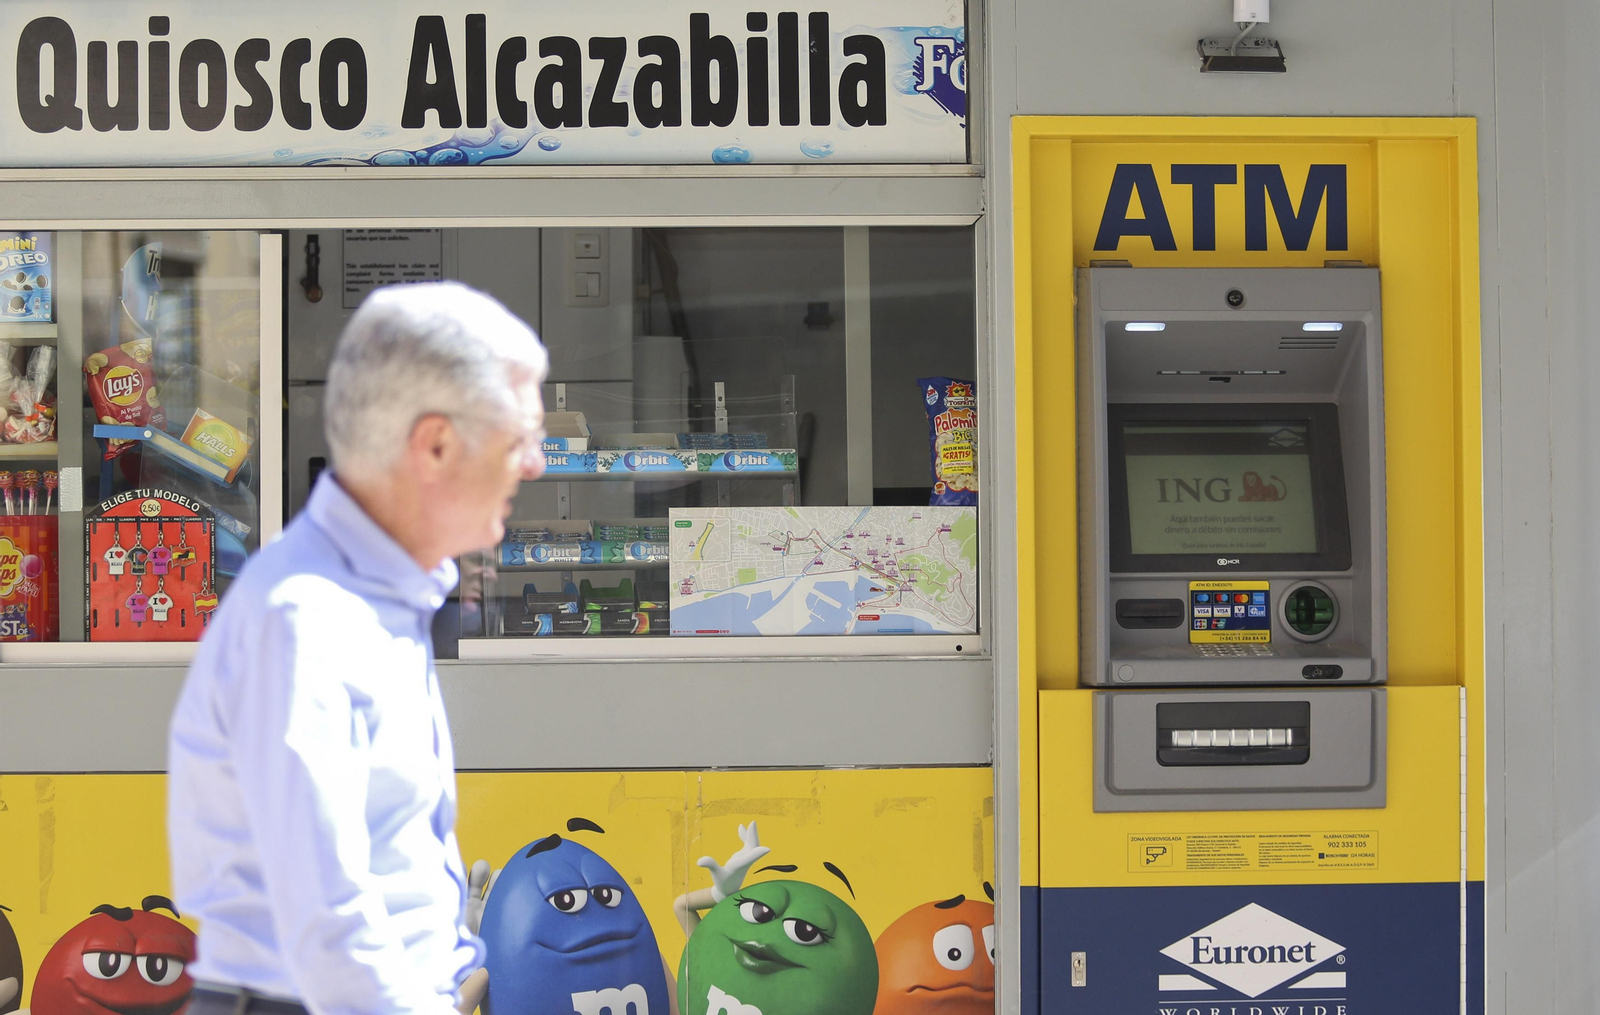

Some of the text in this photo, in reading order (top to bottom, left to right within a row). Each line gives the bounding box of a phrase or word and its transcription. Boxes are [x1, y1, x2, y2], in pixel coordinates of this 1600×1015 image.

[16, 12, 887, 133] Quiosco Alcazabilla
[1094, 164, 1348, 251] ATM
[107, 373, 140, 398] Lay's
[194, 432, 236, 458] HALLS
[541, 442, 560, 450] rbit
[624, 452, 670, 471] Orbit
[724, 451, 769, 471] Orbit
[101, 489, 200, 512] ELIGE TU MODELO
[1156, 477, 1232, 503] ING
[1223, 515, 1251, 524] puedes
[0, 554, 18, 567] pa
[530, 543, 571, 563] Orbit
[630, 541, 669, 560] Orbit
[1189, 936, 1316, 964] Euronet
